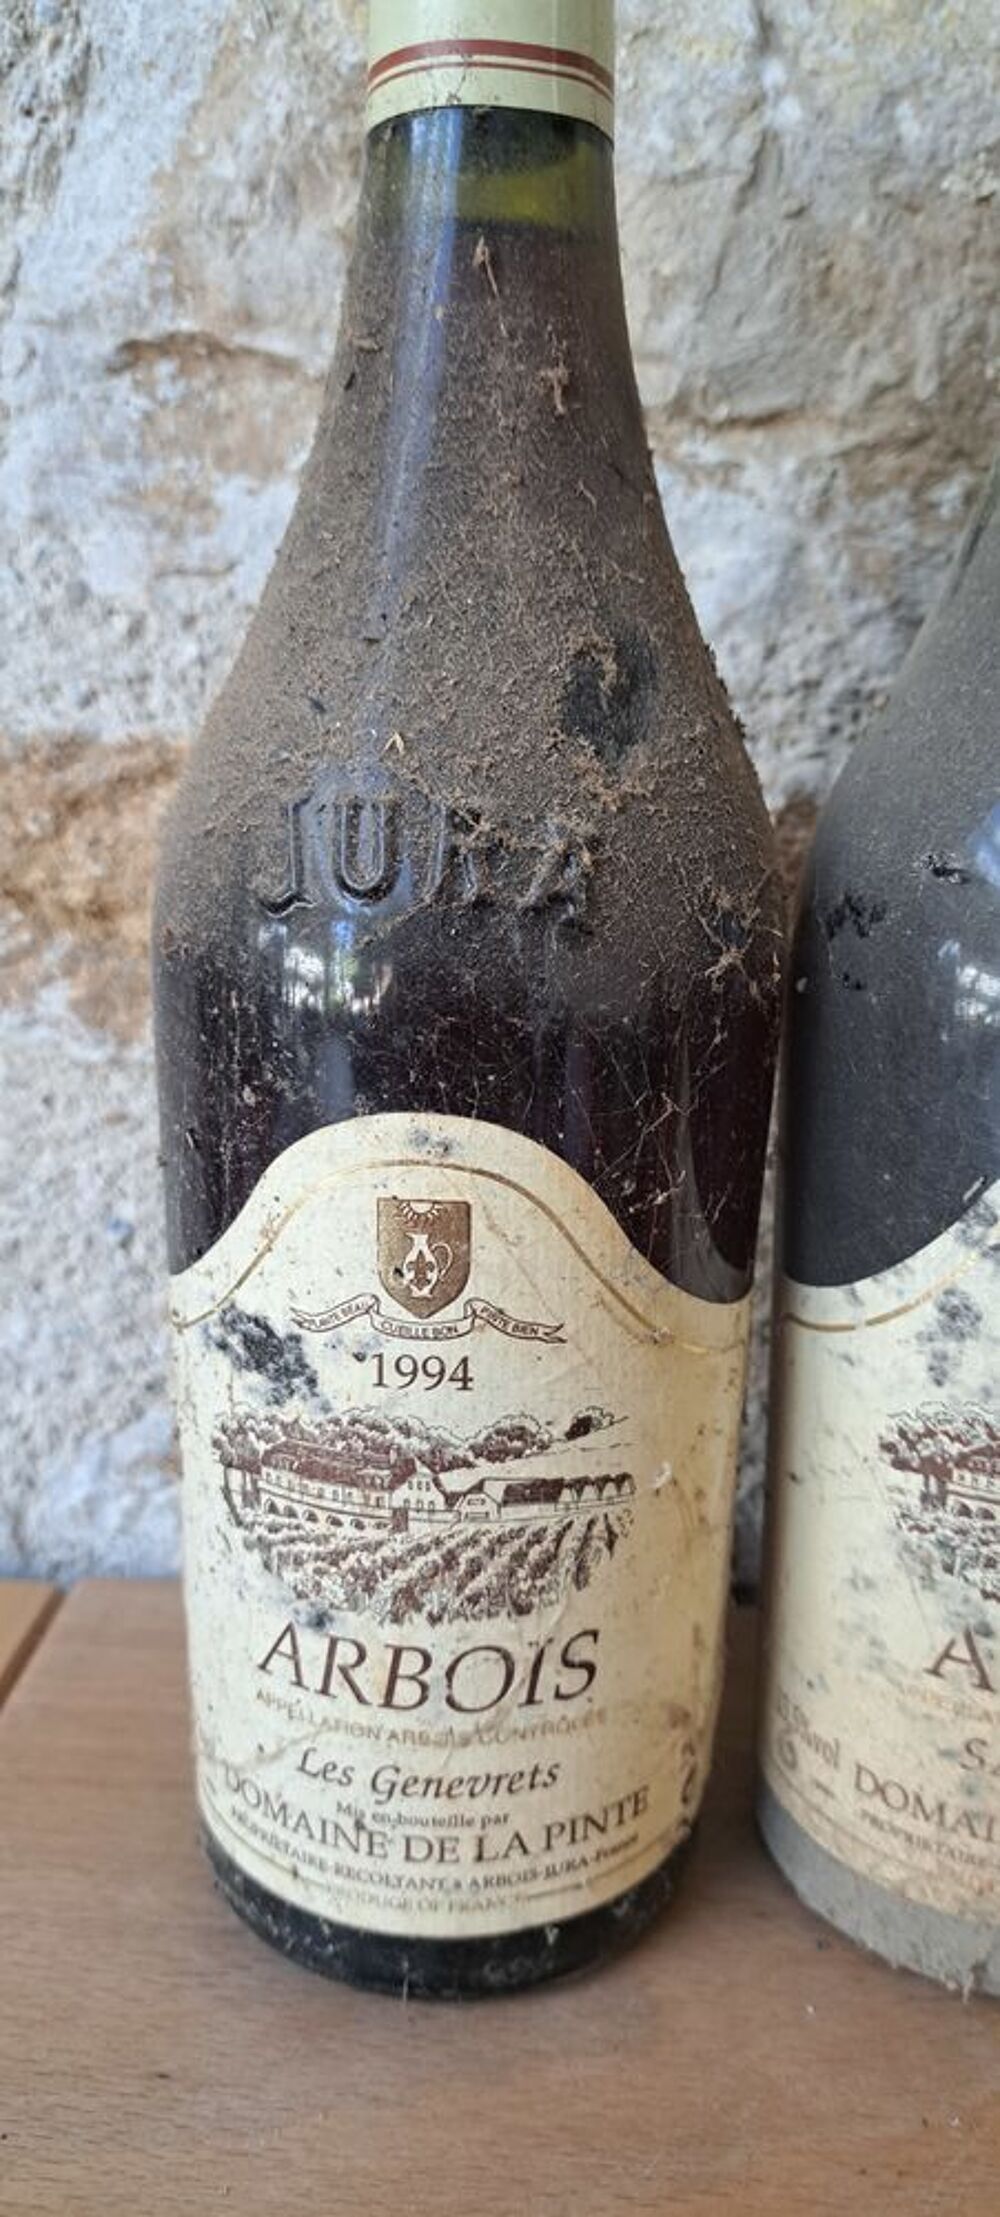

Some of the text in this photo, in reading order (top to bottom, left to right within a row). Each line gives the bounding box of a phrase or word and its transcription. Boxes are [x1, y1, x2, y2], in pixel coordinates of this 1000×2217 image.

[372, 1354, 474, 1391] 1994
[297, 1746, 560, 1805] Les Genevrets
[225, 1762, 650, 1864] DOMAINE DE LA PINTE
[337, 1801, 366, 1820] Mis
[394, 1811, 475, 1829] bouteille
[480, 1812, 509, 1830] par
